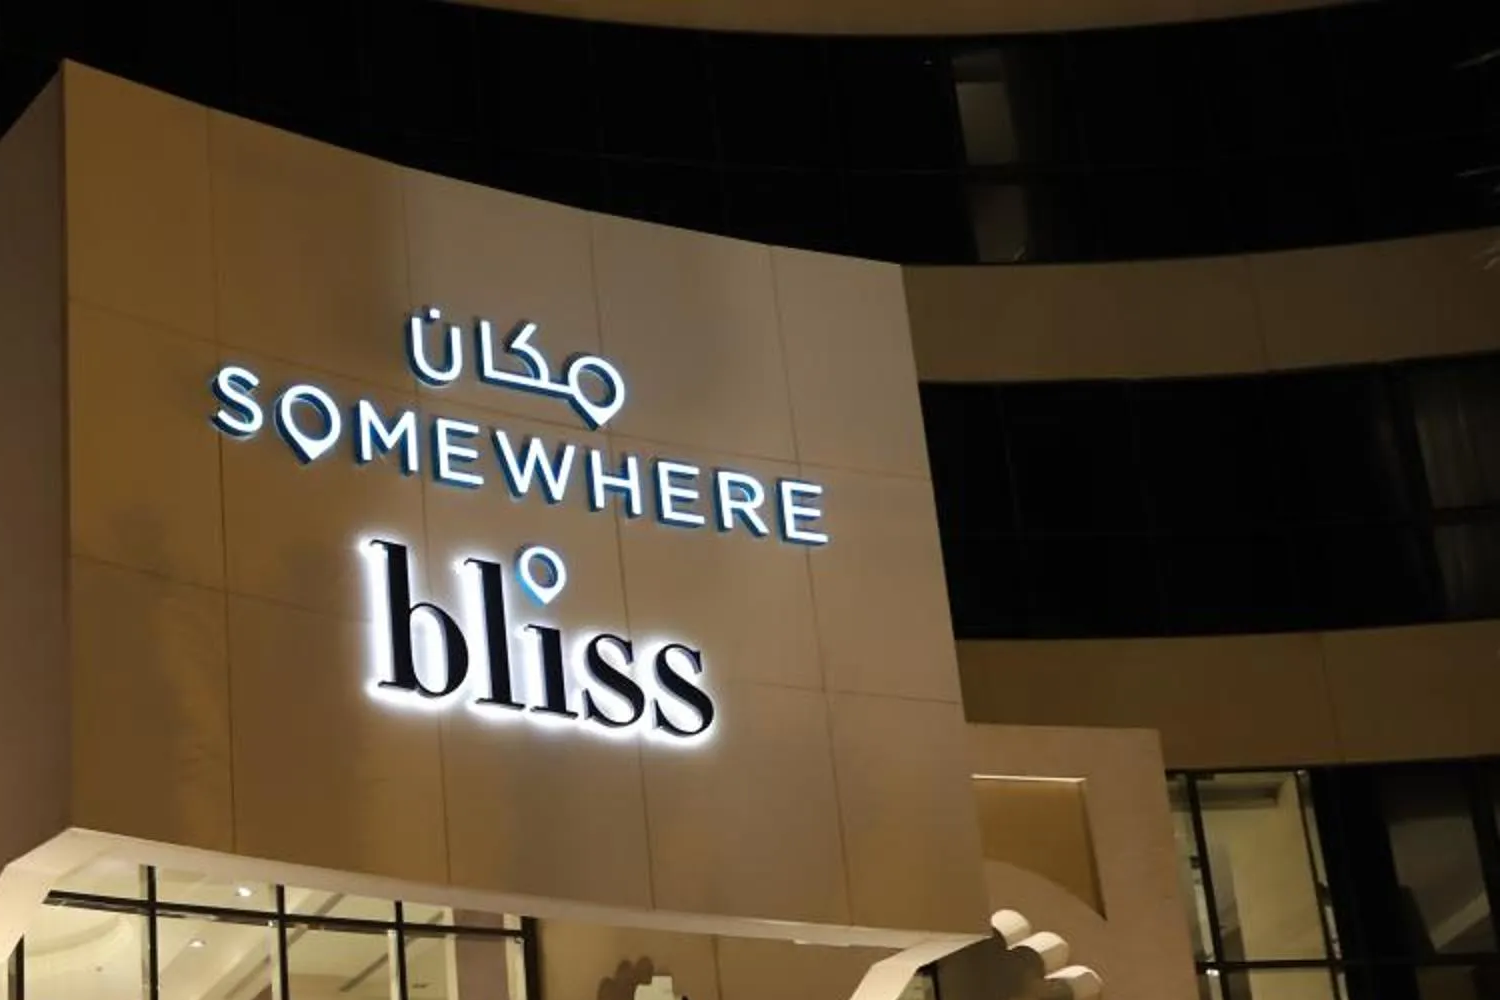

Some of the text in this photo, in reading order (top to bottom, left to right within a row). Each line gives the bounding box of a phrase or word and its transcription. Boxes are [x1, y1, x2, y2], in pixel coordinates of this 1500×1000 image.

[211, 365, 829, 547] SOMEWHERE
[406, 307, 625, 429] مكان
[367, 538, 716, 737] bliss
